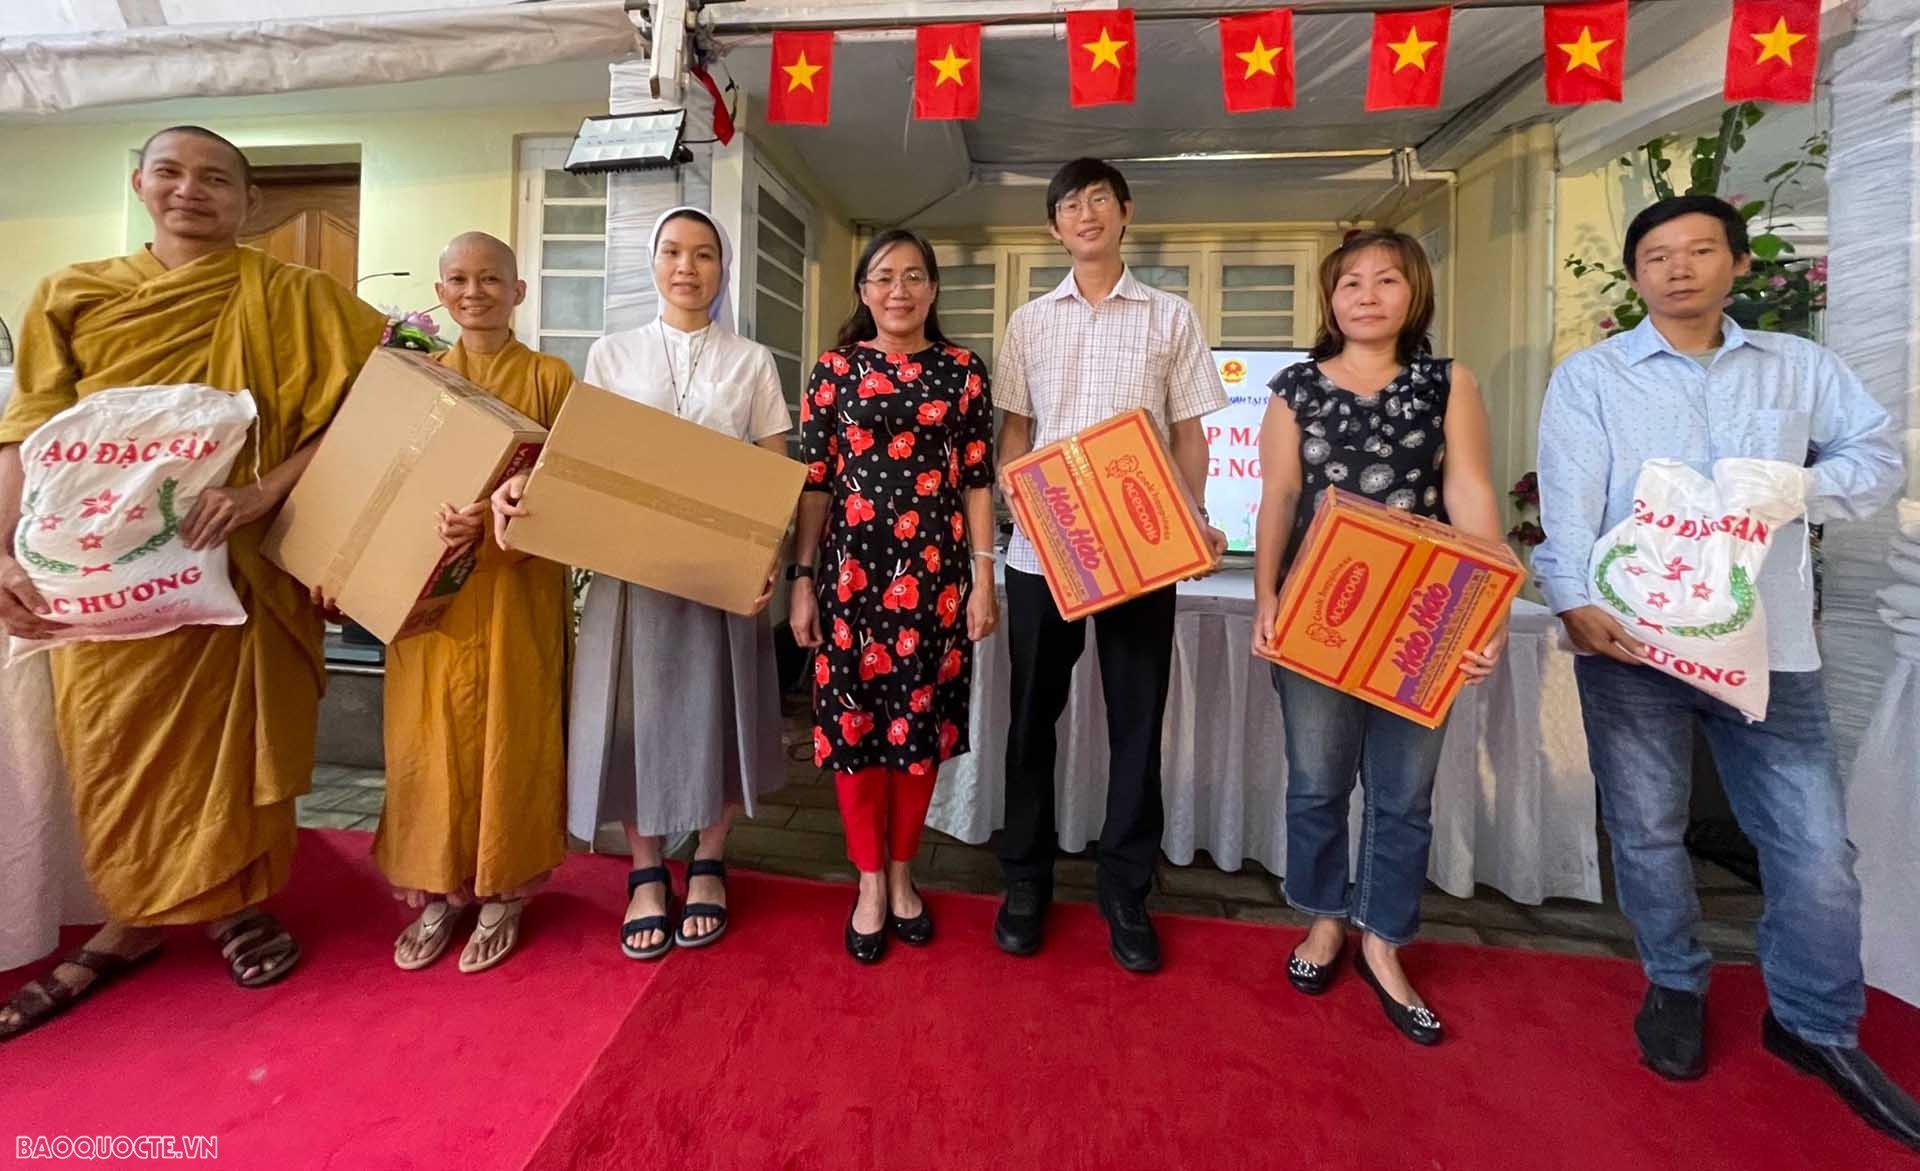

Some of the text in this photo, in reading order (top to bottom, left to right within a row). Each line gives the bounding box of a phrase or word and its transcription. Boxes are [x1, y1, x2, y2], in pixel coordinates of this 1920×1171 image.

[40, 440, 89, 467] ẠO
[94, 436, 161, 469] ĐẶC
[1207, 426, 1222, 445] P
[1207, 457, 1263, 479] G NG
[1719, 508, 1769, 544] SẢN
[77, 566, 202, 615] HƯƠNG
[1646, 644, 1747, 687] ƯƠNG
